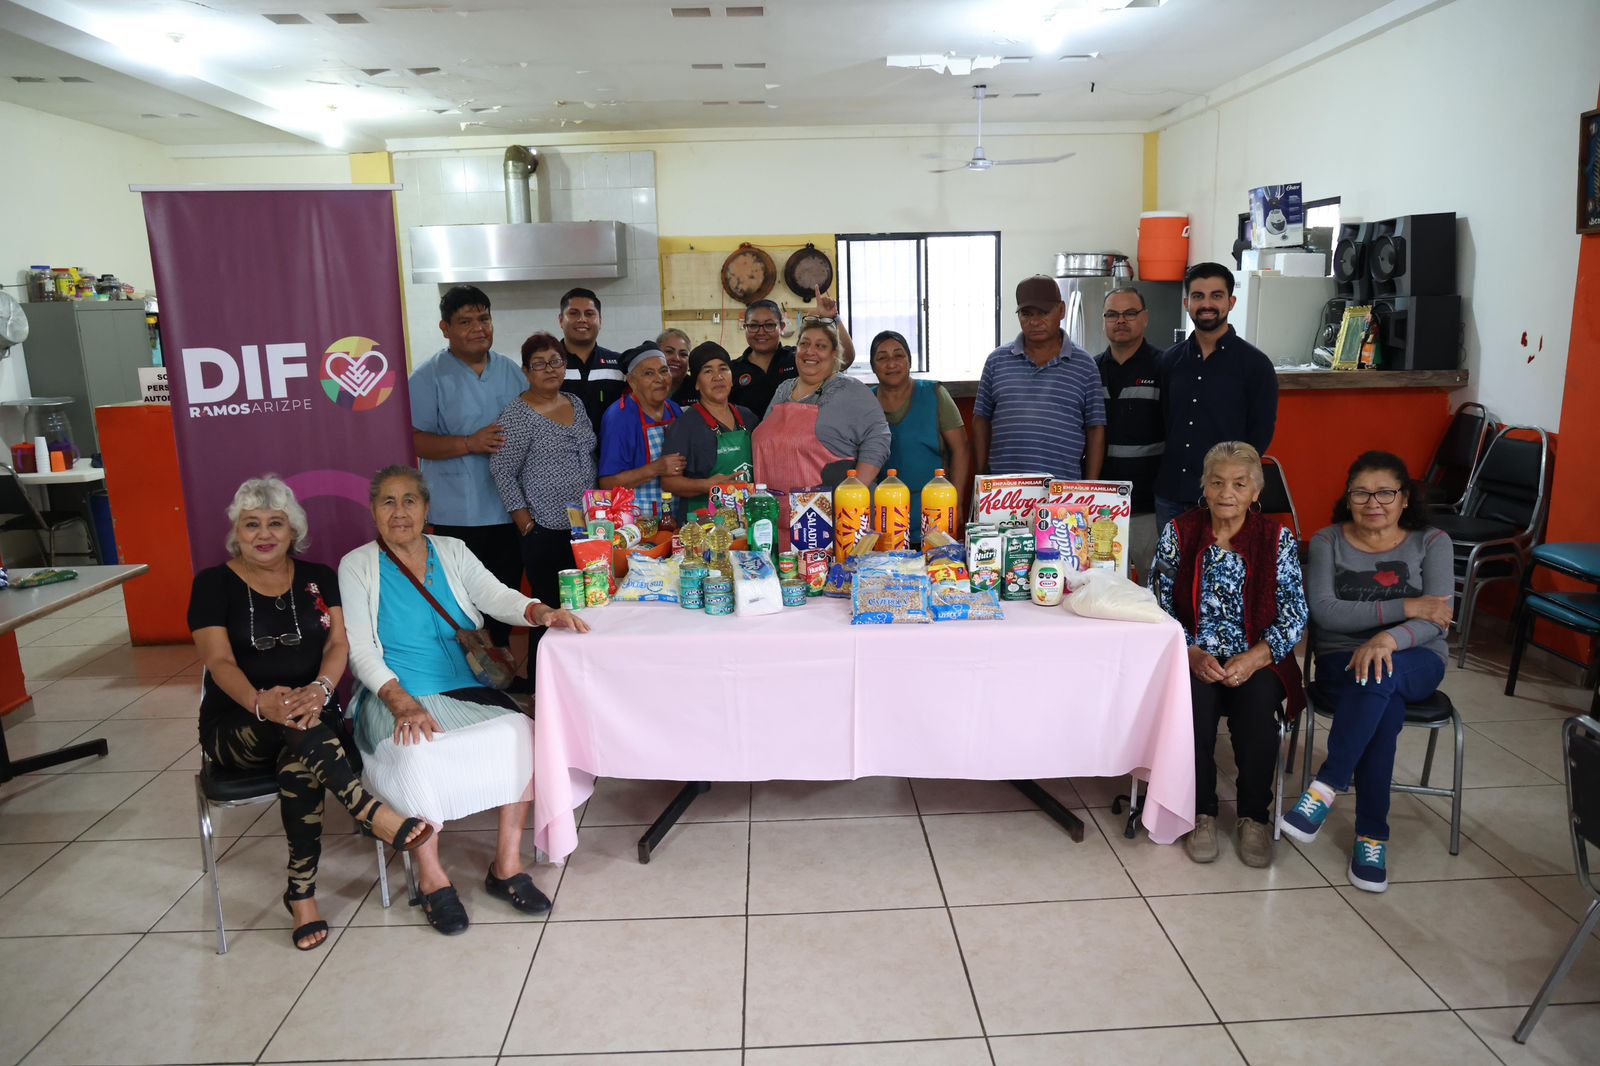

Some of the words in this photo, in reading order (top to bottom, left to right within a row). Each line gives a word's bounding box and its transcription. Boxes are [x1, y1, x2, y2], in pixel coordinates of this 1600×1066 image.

[182, 343, 308, 404] DIF
[983, 482, 992, 490] 13
[1053, 485, 1062, 493] 13
[974, 552, 996, 561] Nutri
[808, 564, 826, 574] Hunt's
